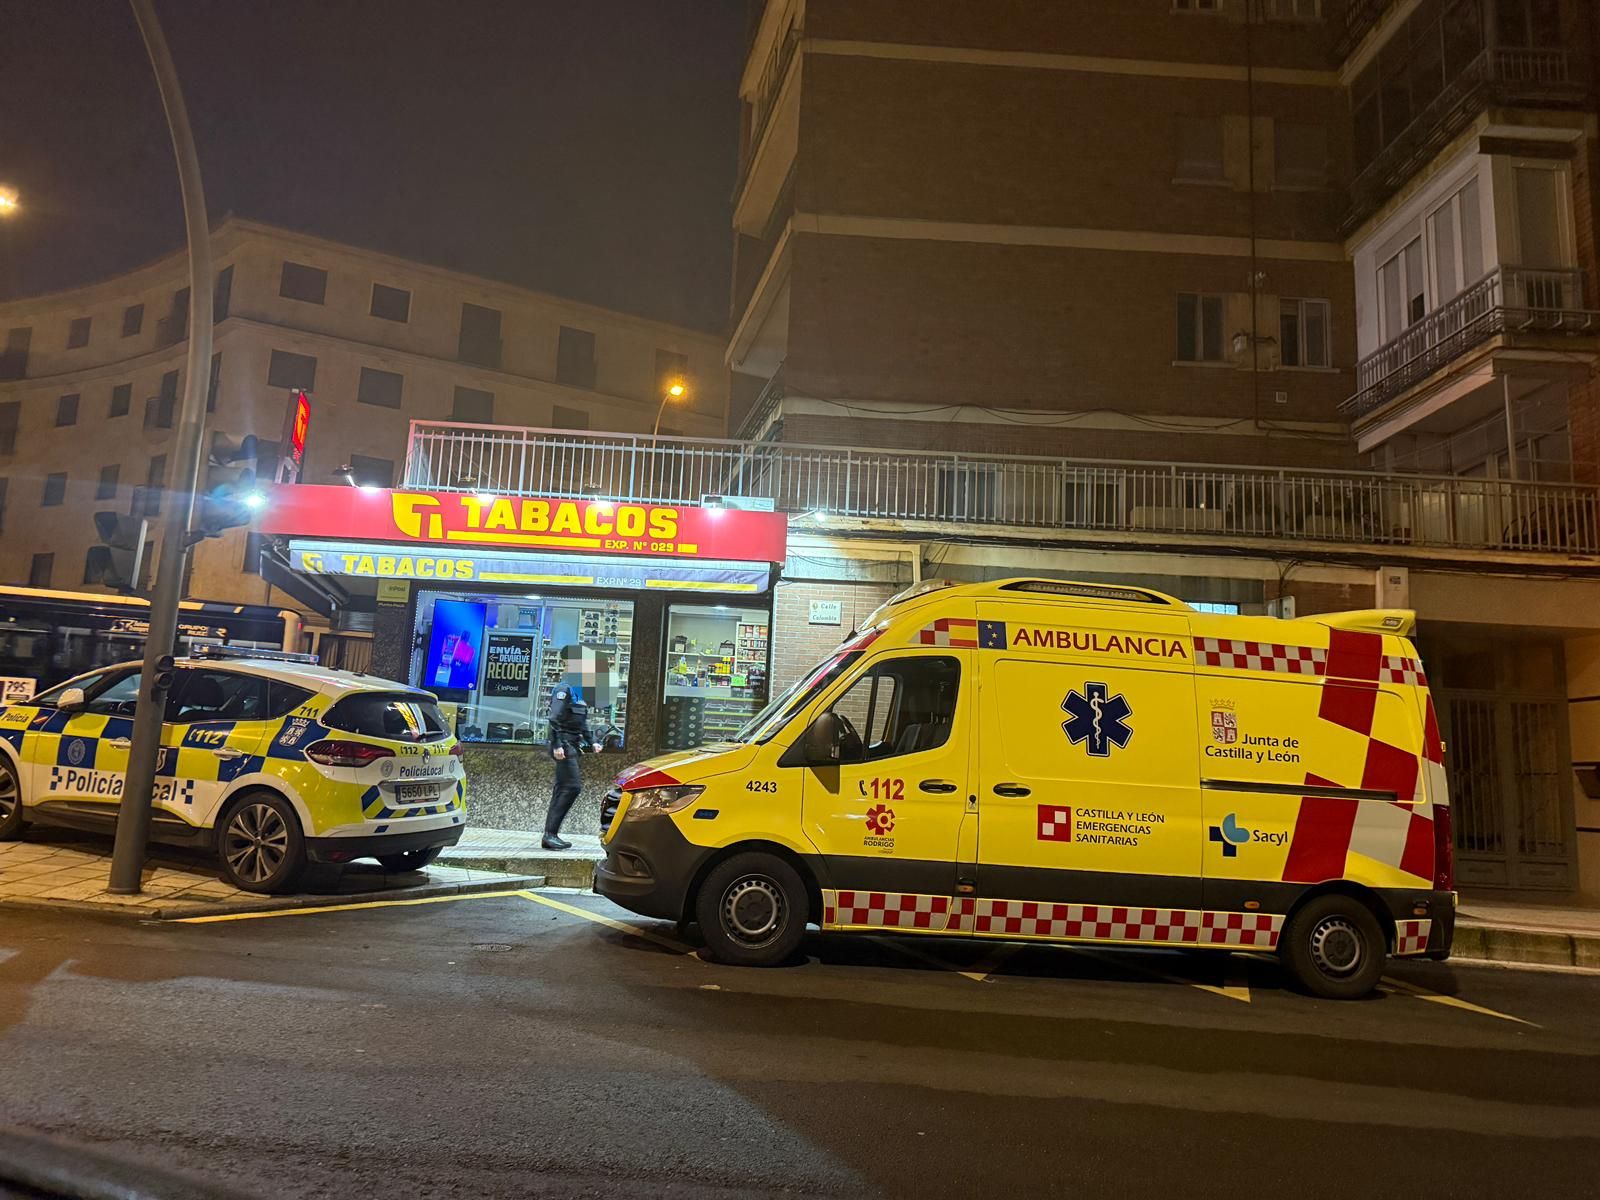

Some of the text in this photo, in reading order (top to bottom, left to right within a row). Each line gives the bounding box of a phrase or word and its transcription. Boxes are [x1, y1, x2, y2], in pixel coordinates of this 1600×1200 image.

[460, 496, 678, 539] TABACOS
[605, 540, 629, 549] EXP.
[651, 543, 674, 552] 029
[341, 555, 475, 579] TABACOS
[629, 579, 642, 587] 29
[489, 645, 521, 654] ENVÍA
[1012, 628, 1187, 658] AMBULANCIA
[499, 655, 530, 663] DEVUELVE
[487, 662, 529, 680] RECOGE
[7, 681, 26, 692] 795
[300, 706, 319, 717] 711
[196, 730, 224, 745] 112
[1241, 734, 1299, 748] Junta de
[404, 746, 418, 754] 112
[1205, 746, 1300, 763] Castilla y León
[65, 770, 178, 801] Policía cal
[401, 782, 438, 798] 5650 LPL
[746, 780, 777, 793] 4243
[870, 777, 905, 800] 112
[1076, 808, 1164, 823] CASTILLA Y LEÓN
[1076, 821, 1151, 835] EMERGENCIAS
[863, 840, 895, 848] RODRIGO
[1076, 833, 1138, 846] SANITARIAS
[1252, 830, 1288, 846] Sacyl
